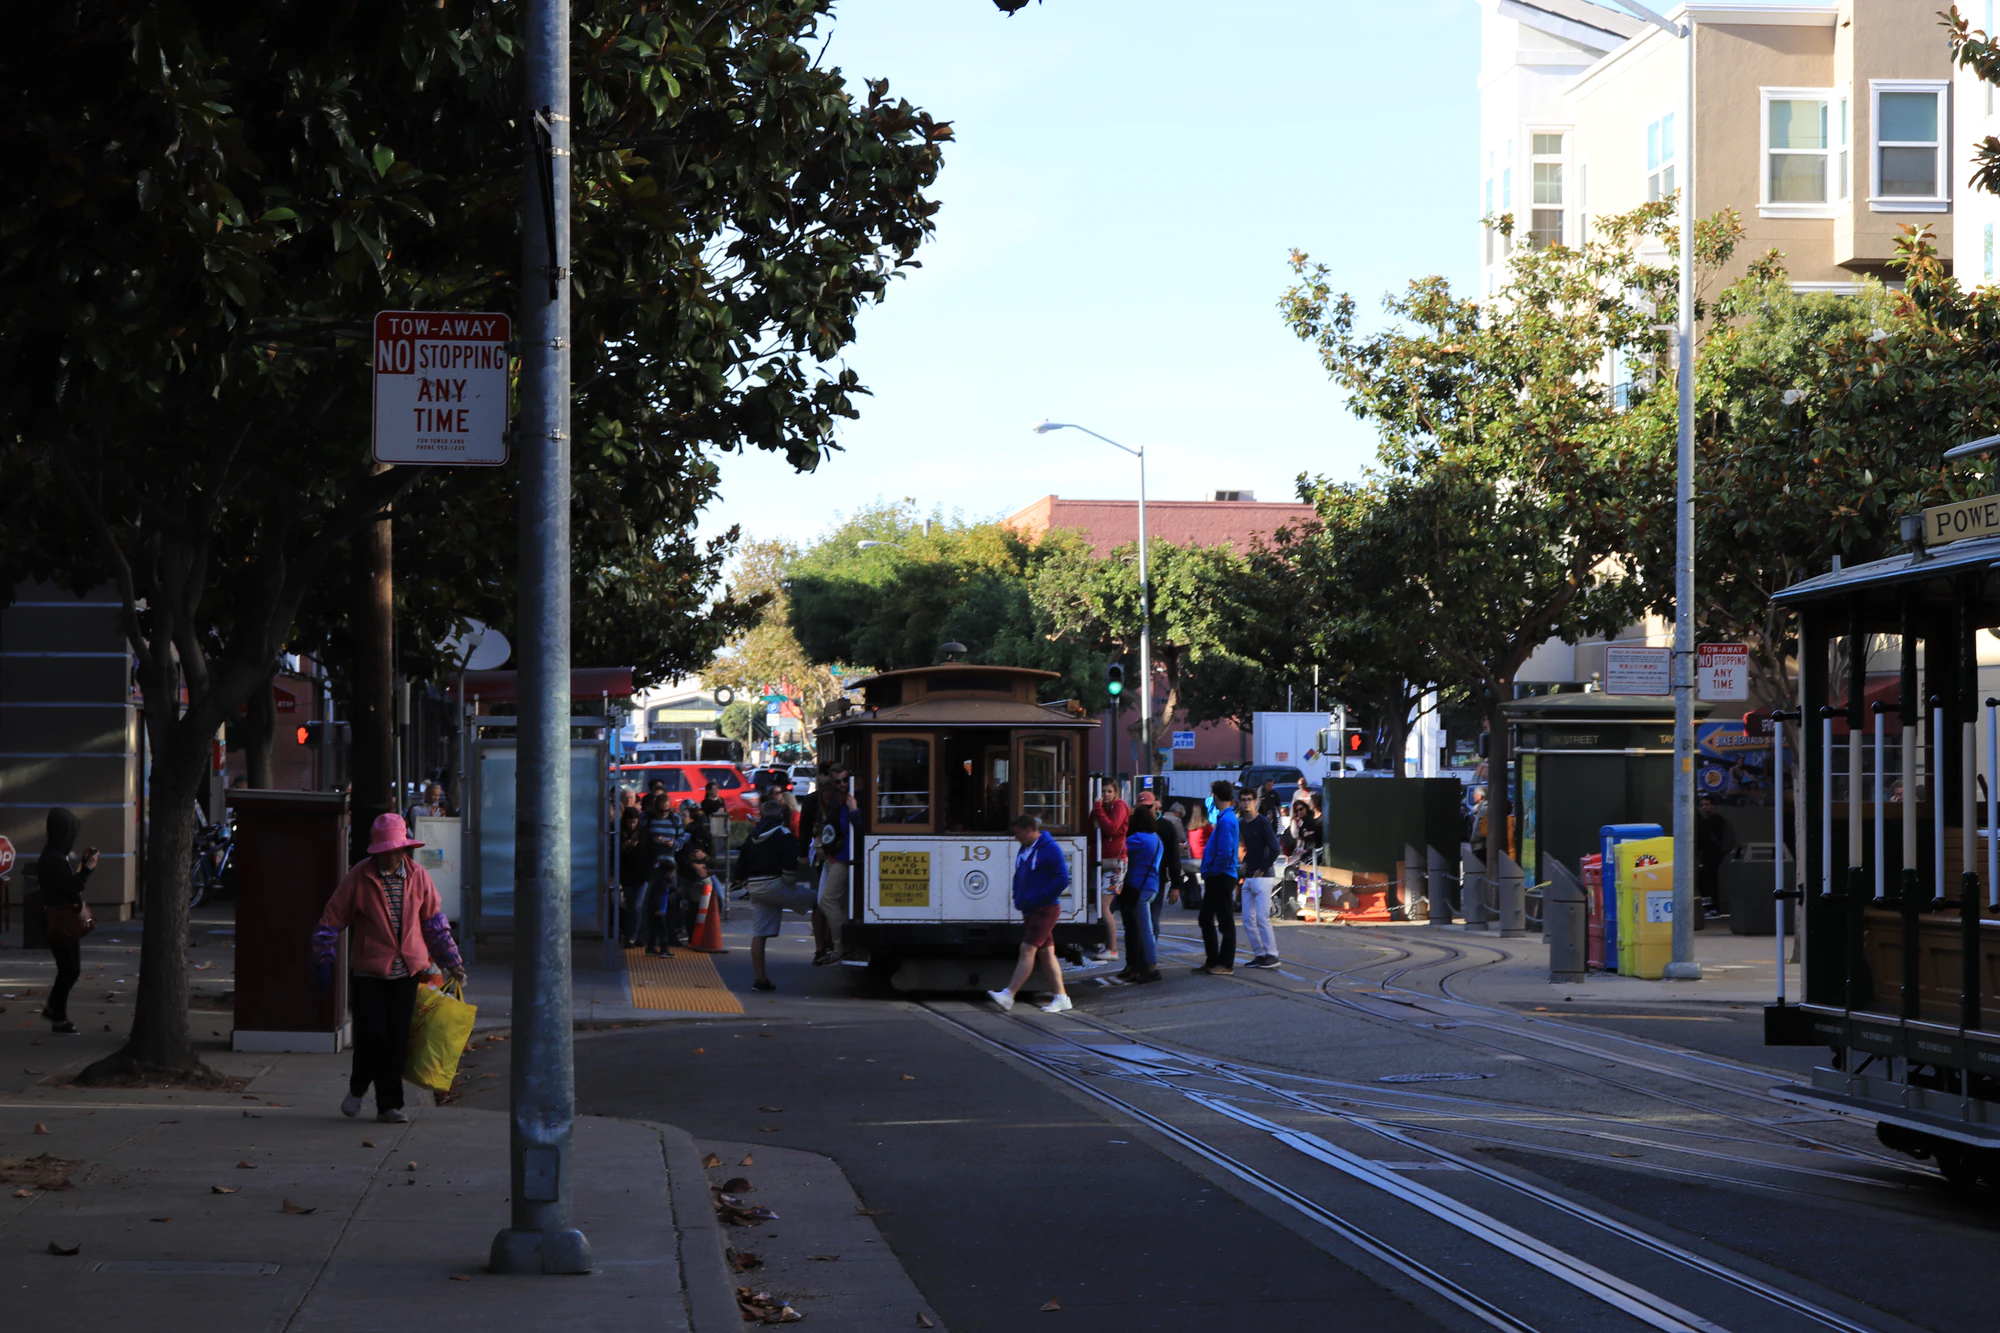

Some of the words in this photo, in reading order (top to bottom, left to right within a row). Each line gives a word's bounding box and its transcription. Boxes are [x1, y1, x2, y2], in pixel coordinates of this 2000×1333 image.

[389, 318, 496, 336] TOW-AWAY
[378, 339, 411, 372] NO
[420, 344, 504, 370] STOPPING
[418, 378, 468, 402] ANY
[414, 408, 470, 432] TIME
[1699, 654, 1712, 667] NO
[1714, 656, 1746, 666] STOPPING
[1714, 669, 1732, 678] ANY
[1713, 680, 1734, 689] TIME
[1564, 735, 1600, 744] STREET
[1716, 736, 1732, 746] BIKE
[1734, 736, 1764, 746] RENTALS
[962, 846, 990, 861] 19
